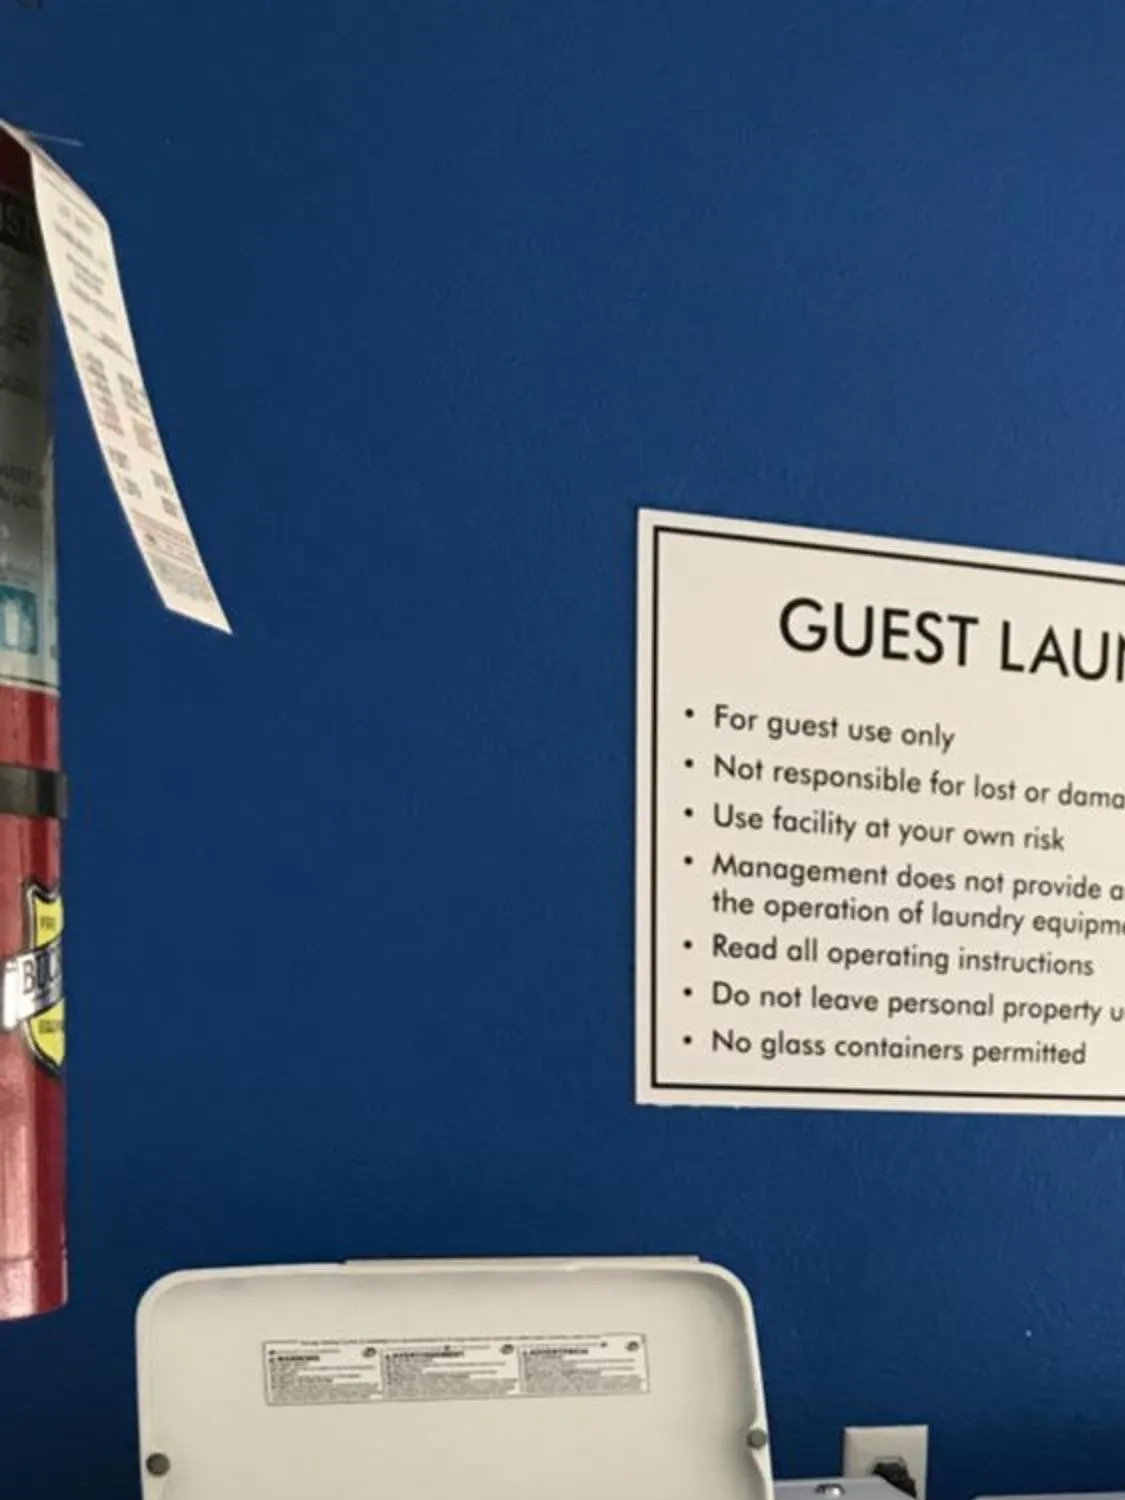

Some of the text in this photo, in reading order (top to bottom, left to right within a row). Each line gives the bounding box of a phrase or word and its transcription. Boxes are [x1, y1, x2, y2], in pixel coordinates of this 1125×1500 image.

[780, 598, 979, 666] GUEST
[715, 704, 955, 754] For guest use only
[714, 754, 763, 780] Not
[773, 766, 921, 794] responsible
[929, 770, 965, 796] for
[974, 774, 1016, 800] lost
[1024, 786, 1050, 803] or
[714, 802, 1064, 851] Use facility at your own risk
[712, 853, 887, 887] Management
[896, 864, 956, 891] does
[965, 873, 1004, 893] not
[1012, 875, 1102, 900] provide
[712, 888, 754, 915] the
[764, 897, 889, 923] operation
[898, 900, 924, 924] of
[932, 901, 1025, 936] laundry
[713, 933, 1094, 976] Read all operating instructions
[712, 981, 750, 1007] Do
[760, 988, 802, 1008] not
[812, 984, 878, 1012] leave
[888, 993, 994, 1018] personal
[1003, 1001, 1102, 1026] property
[712, 1030, 1086, 1067] No glass containers permitted
